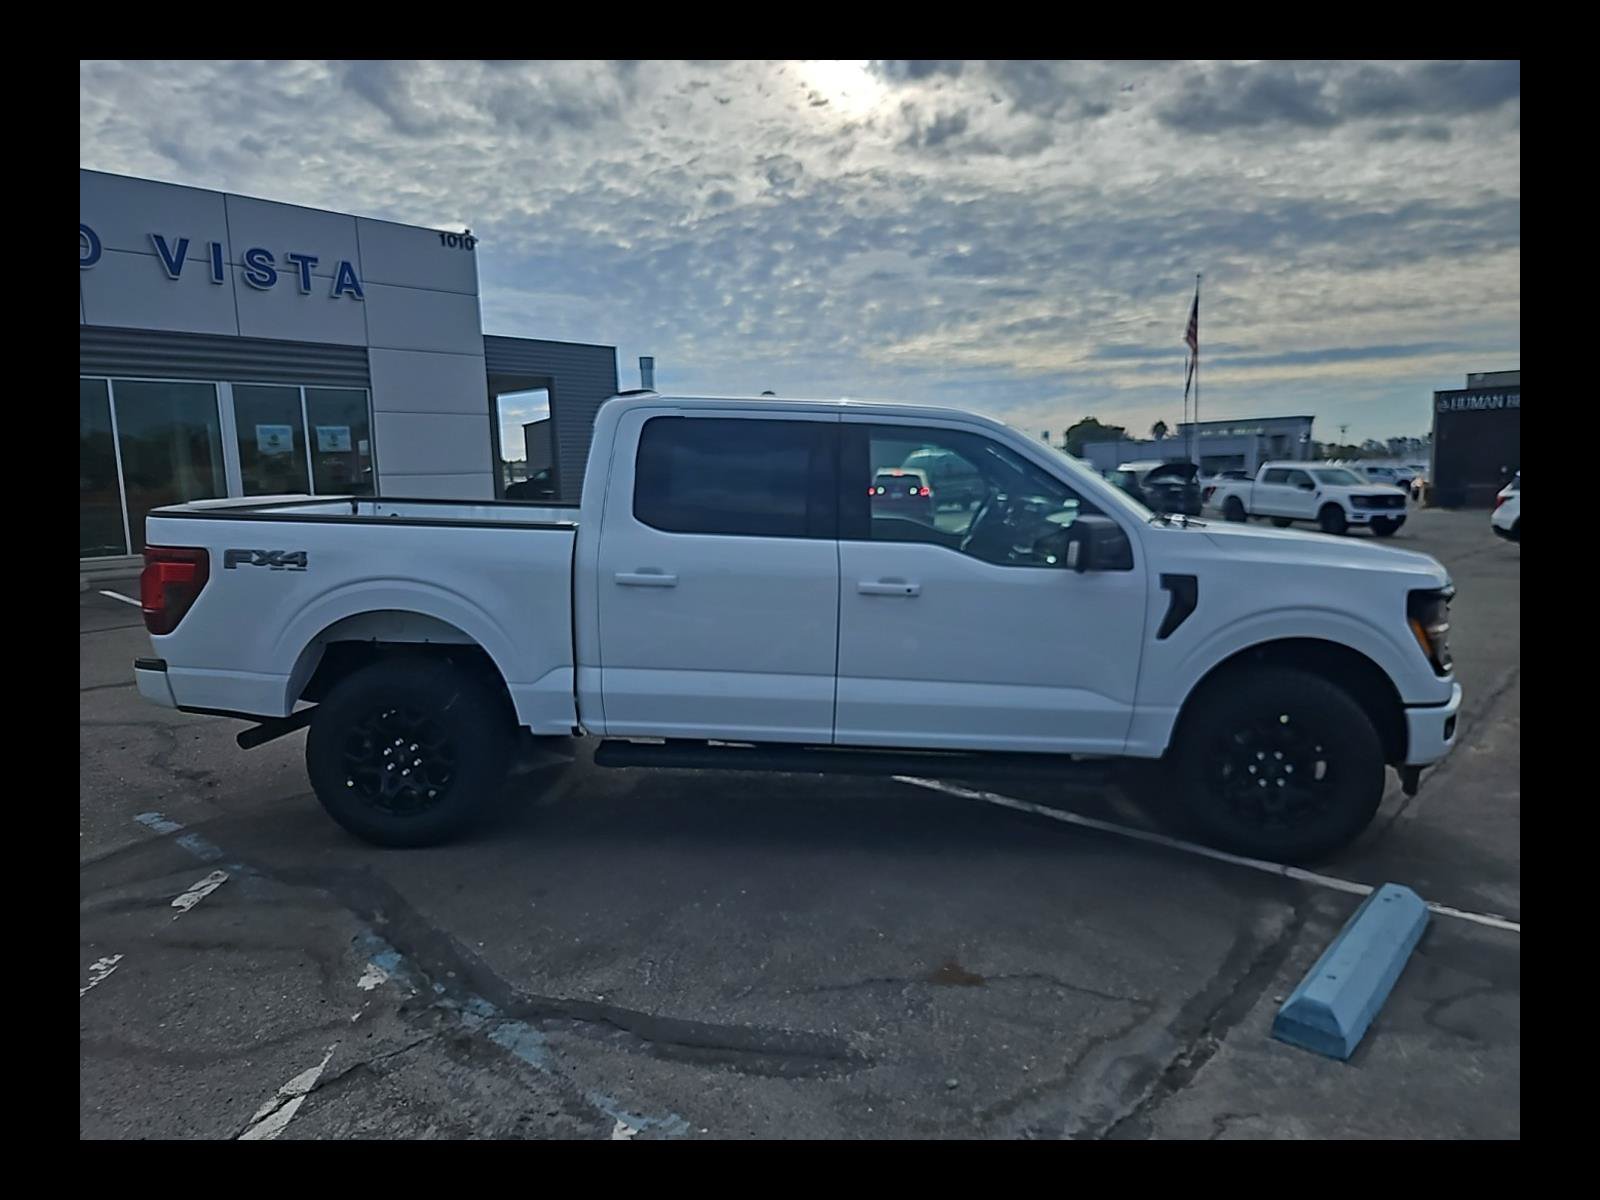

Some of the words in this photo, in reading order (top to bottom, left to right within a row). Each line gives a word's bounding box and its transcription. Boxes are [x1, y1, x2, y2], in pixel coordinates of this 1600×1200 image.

[440, 233, 475, 251] 1010
[149, 232, 365, 300] VISTA
[224, 549, 308, 570] FX4
